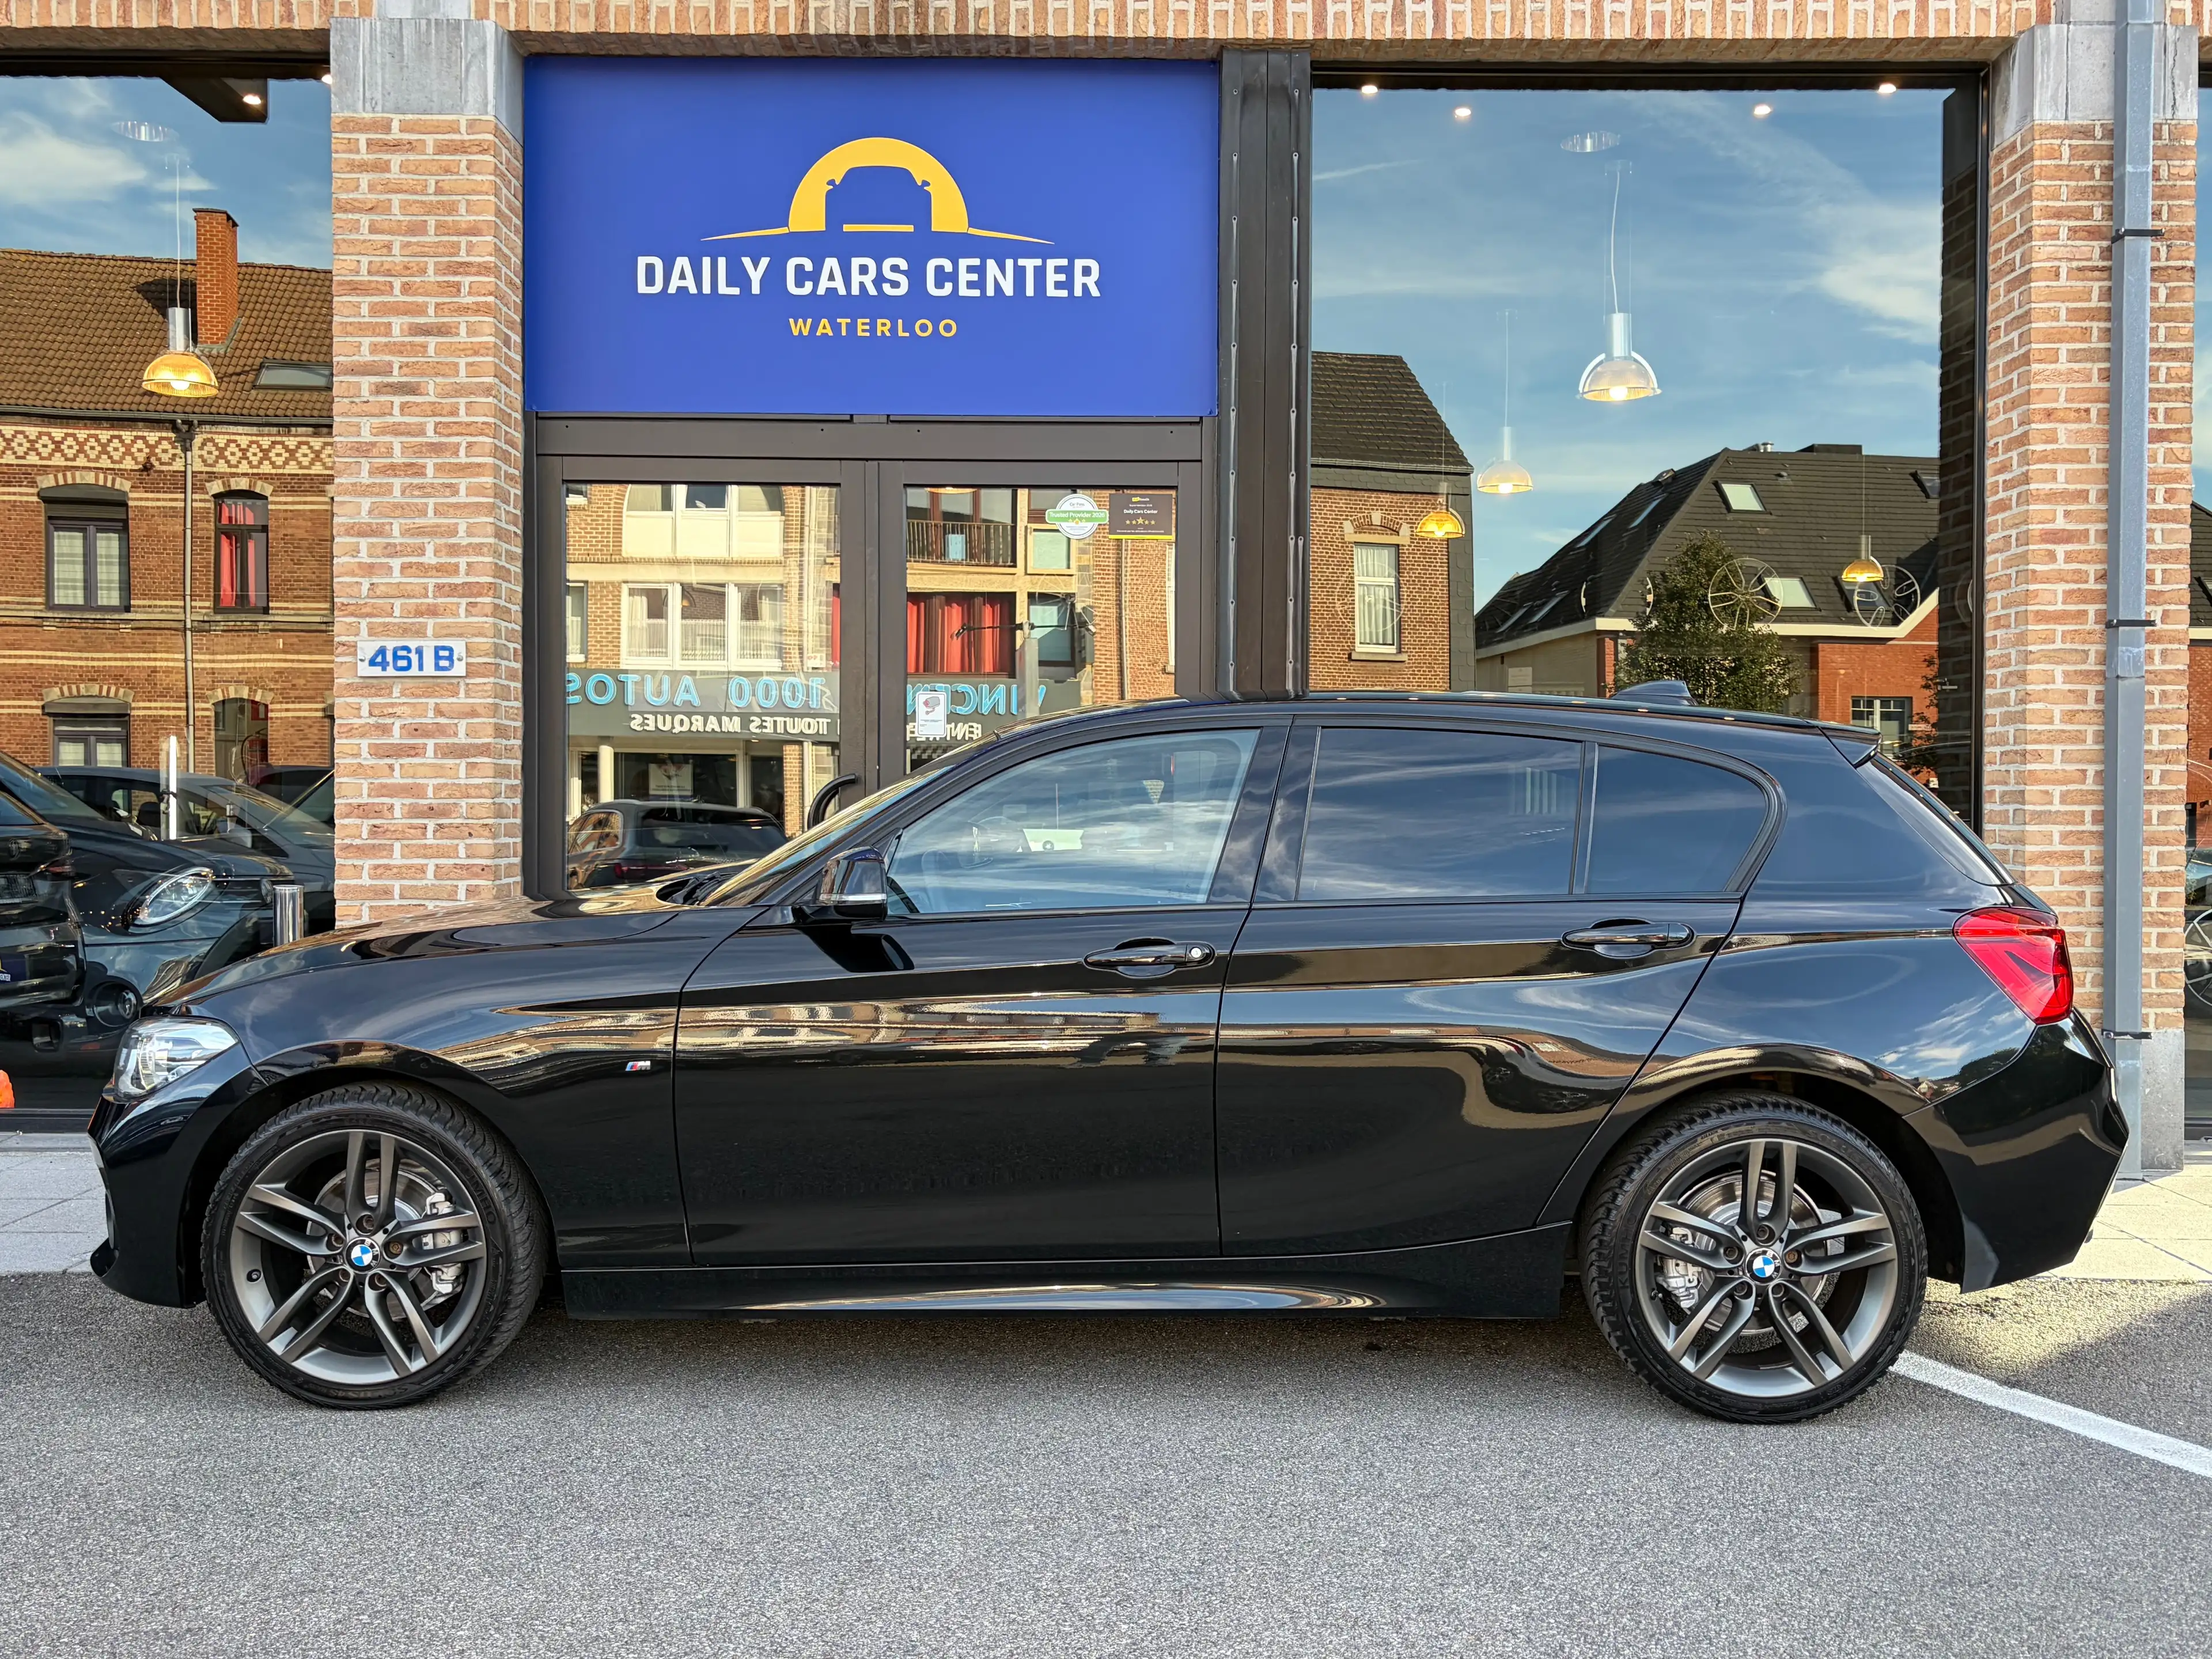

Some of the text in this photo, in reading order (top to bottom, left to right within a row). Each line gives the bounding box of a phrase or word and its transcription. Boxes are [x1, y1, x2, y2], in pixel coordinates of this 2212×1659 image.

[638, 256, 1100, 297] DAILY CARS CENTER
[789, 319, 956, 336] WATERLOO
[369, 645, 454, 672] 461 B
[452, 1156, 496, 1225] KUMHO
[1618, 1213, 1637, 1289] KUMHO
